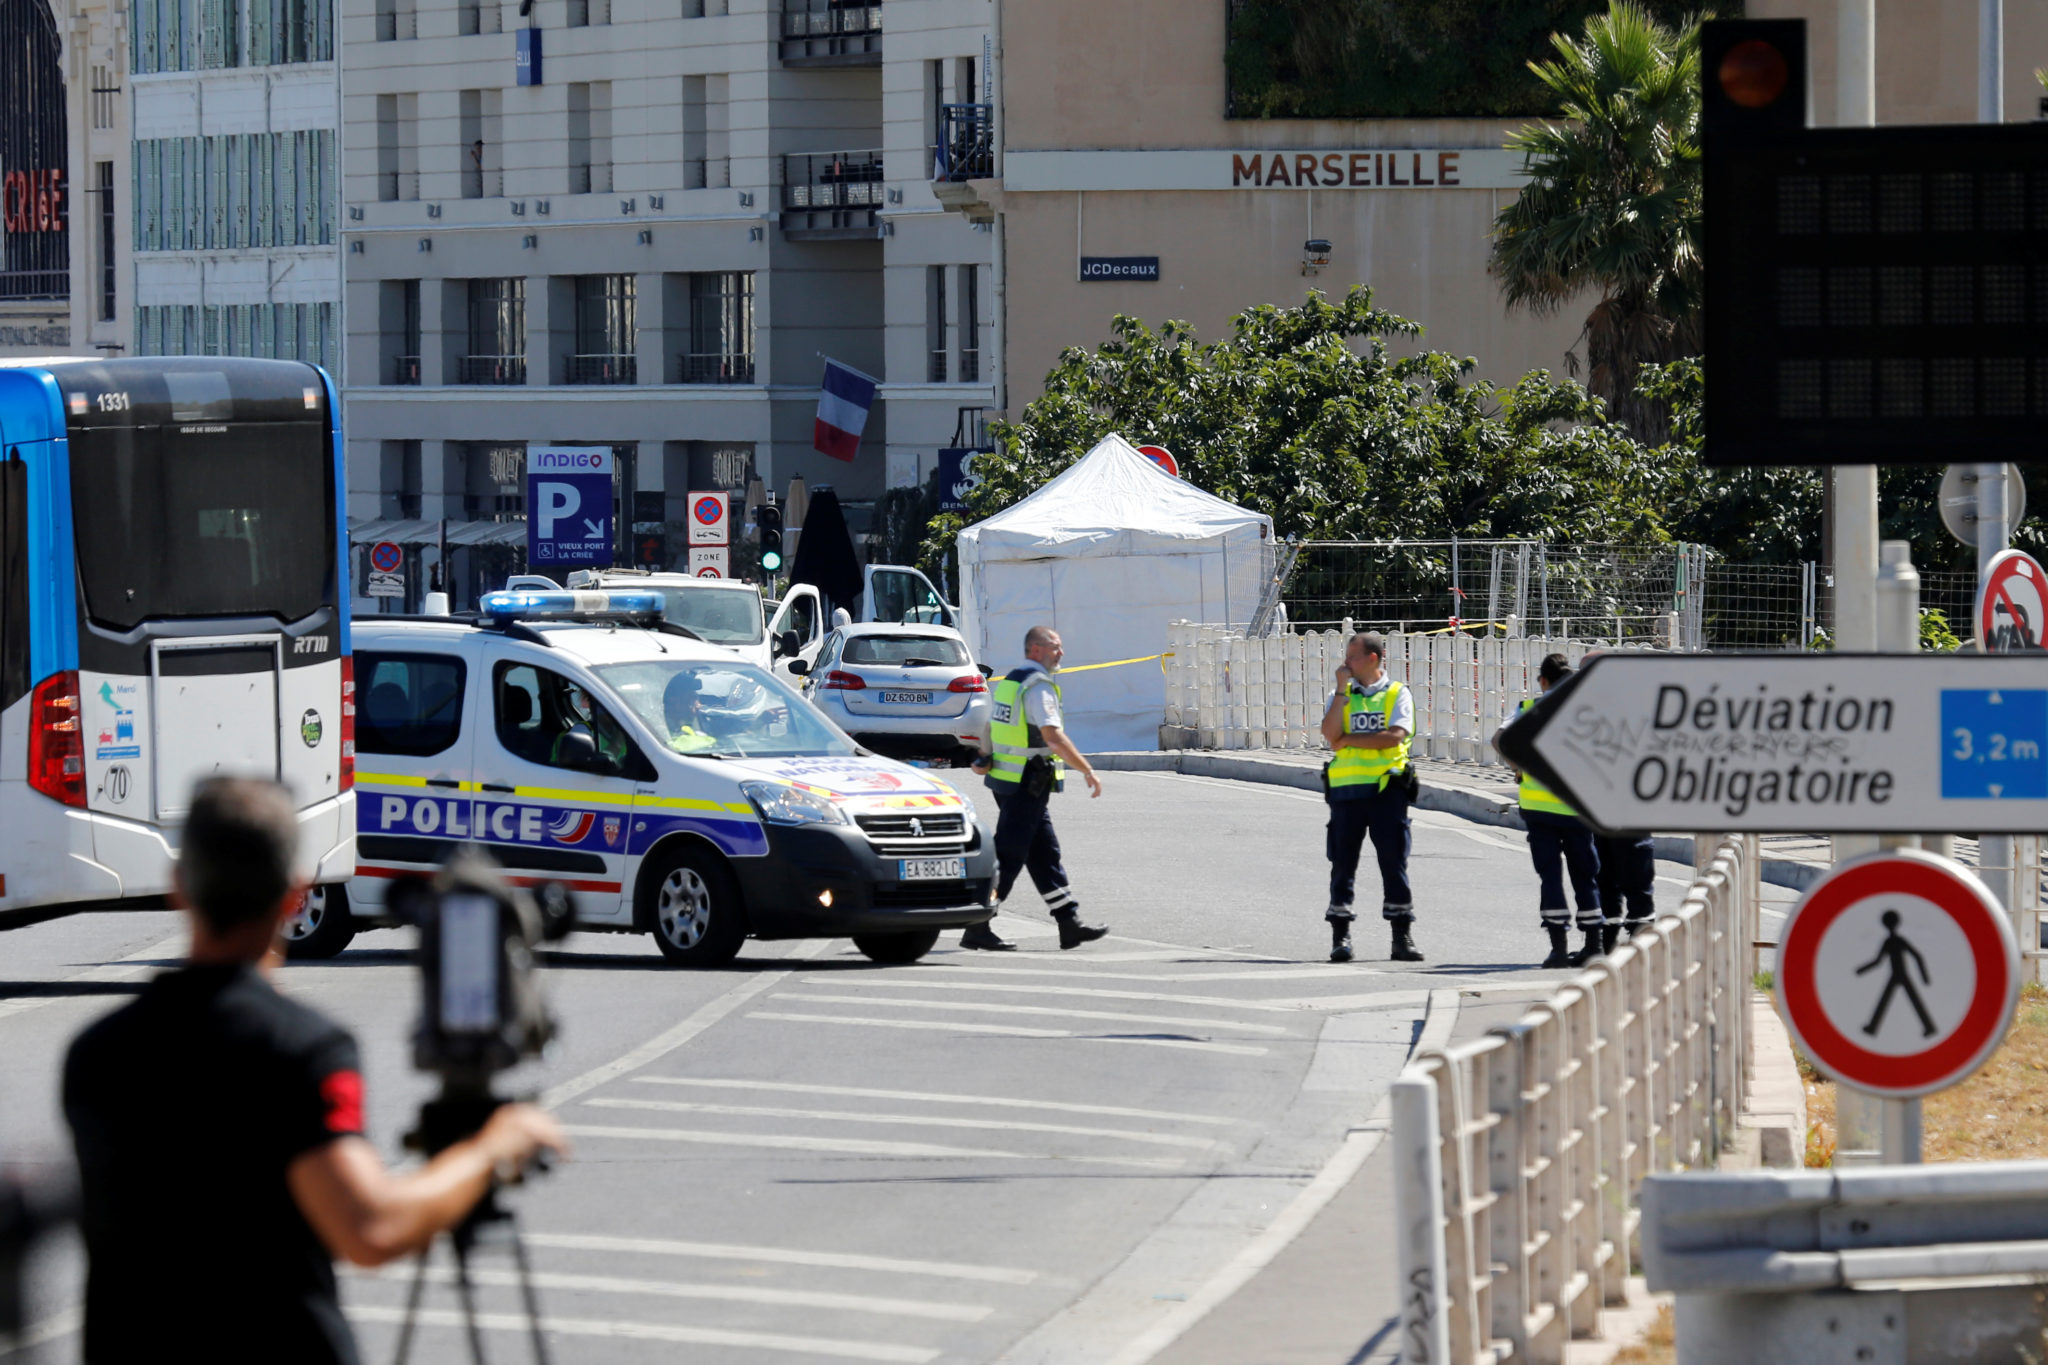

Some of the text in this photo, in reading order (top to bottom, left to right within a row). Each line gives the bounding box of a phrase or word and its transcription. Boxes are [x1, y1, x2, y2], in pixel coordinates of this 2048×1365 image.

[1232, 153, 1460, 187] MARSEILLE
[1083, 263, 1156, 276] JCDecaux
[97, 392, 129, 412] 1331
[538, 454, 602, 468] INDIGO
[537, 482, 581, 539] P
[558, 551, 569, 559] LA
[697, 553, 720, 561] ZONE
[1653, 683, 1894, 733] Déviation
[110, 767, 126, 799] 70
[1632, 756, 1894, 817] Obligatoire
[380, 796, 543, 841] POLICE
